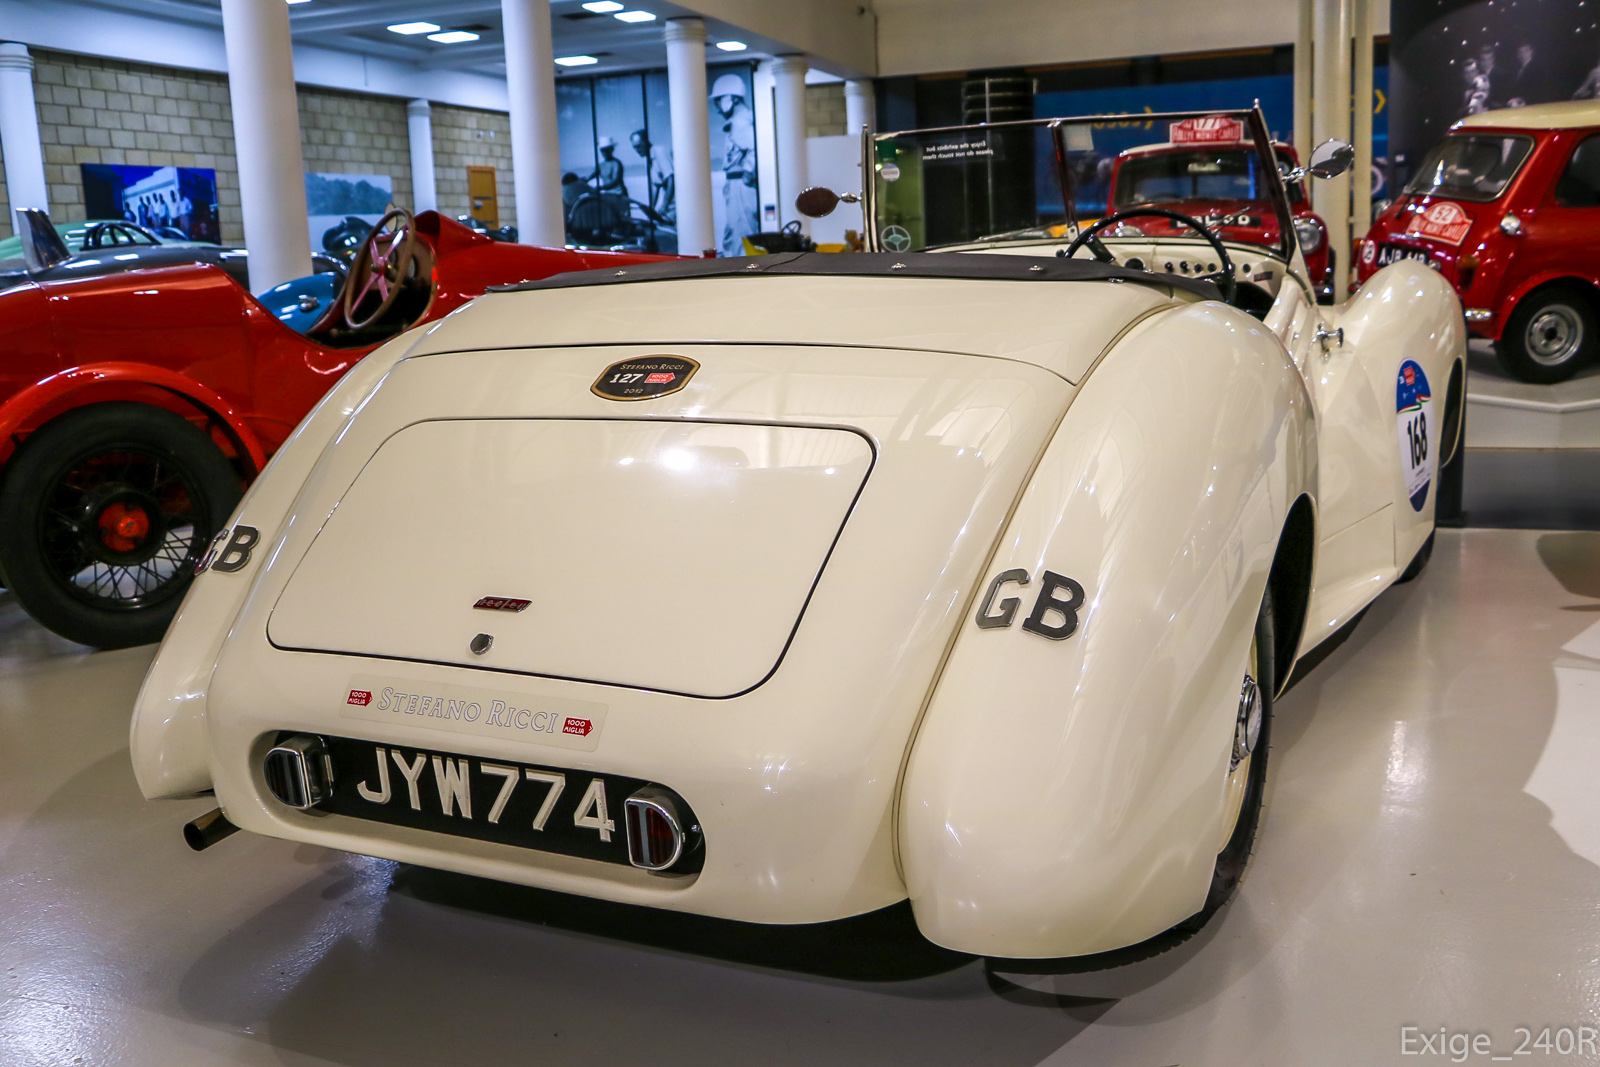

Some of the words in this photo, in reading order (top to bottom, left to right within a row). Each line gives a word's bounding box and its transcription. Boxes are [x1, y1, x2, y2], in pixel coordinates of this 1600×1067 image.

[609, 373, 645, 384] 127
[1407, 411, 1428, 470] 168
[975, 568, 1085, 641] GB
[351, 691, 367, 699] 1000
[348, 697, 366, 705] MIGLIA
[377, 686, 481, 723] STEFANO
[486, 699, 558, 734] RICCI
[567, 719, 586, 727] 1000
[563, 725, 585, 735] MIGLIA
[357, 747, 615, 843] JYW774
